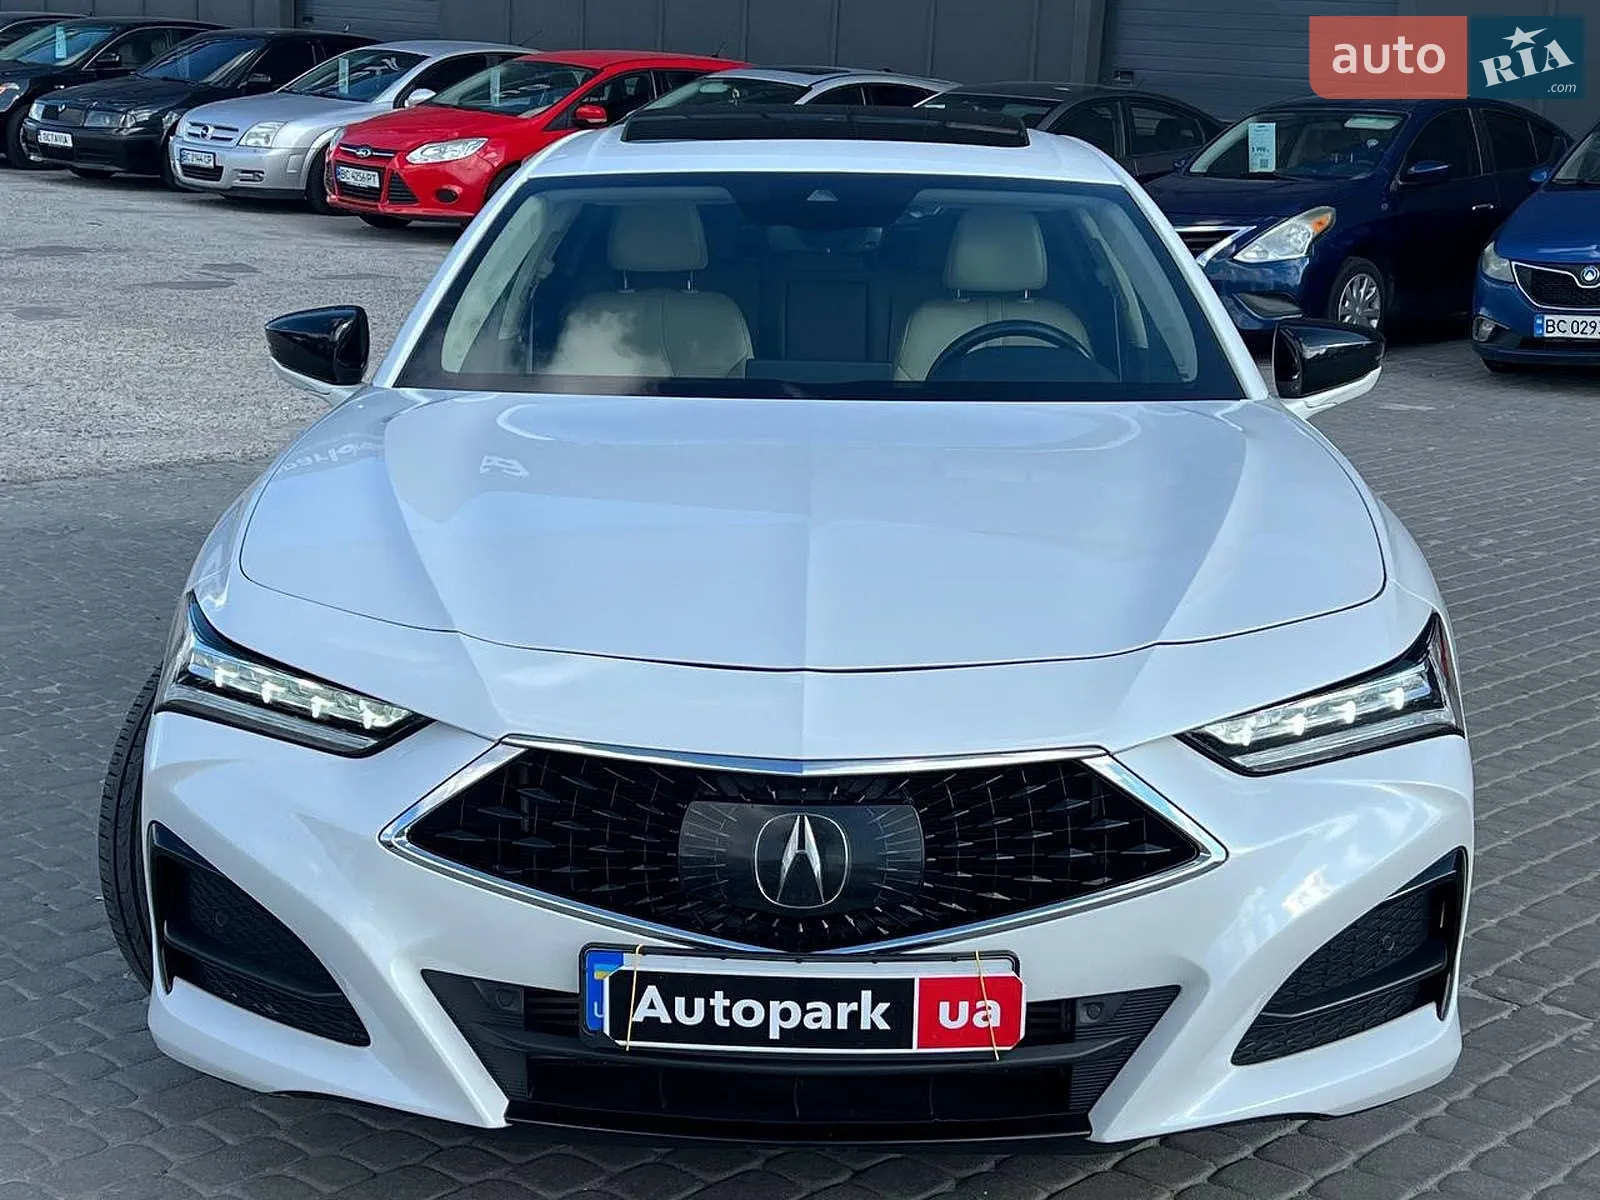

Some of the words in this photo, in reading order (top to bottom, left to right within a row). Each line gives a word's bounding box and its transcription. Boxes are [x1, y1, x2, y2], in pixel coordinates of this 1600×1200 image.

[1545, 319, 1567, 334] BC
[1571, 320, 1600, 336] 029
[632, 985, 890, 1039] Autopark
[938, 998, 1000, 1028] ua
